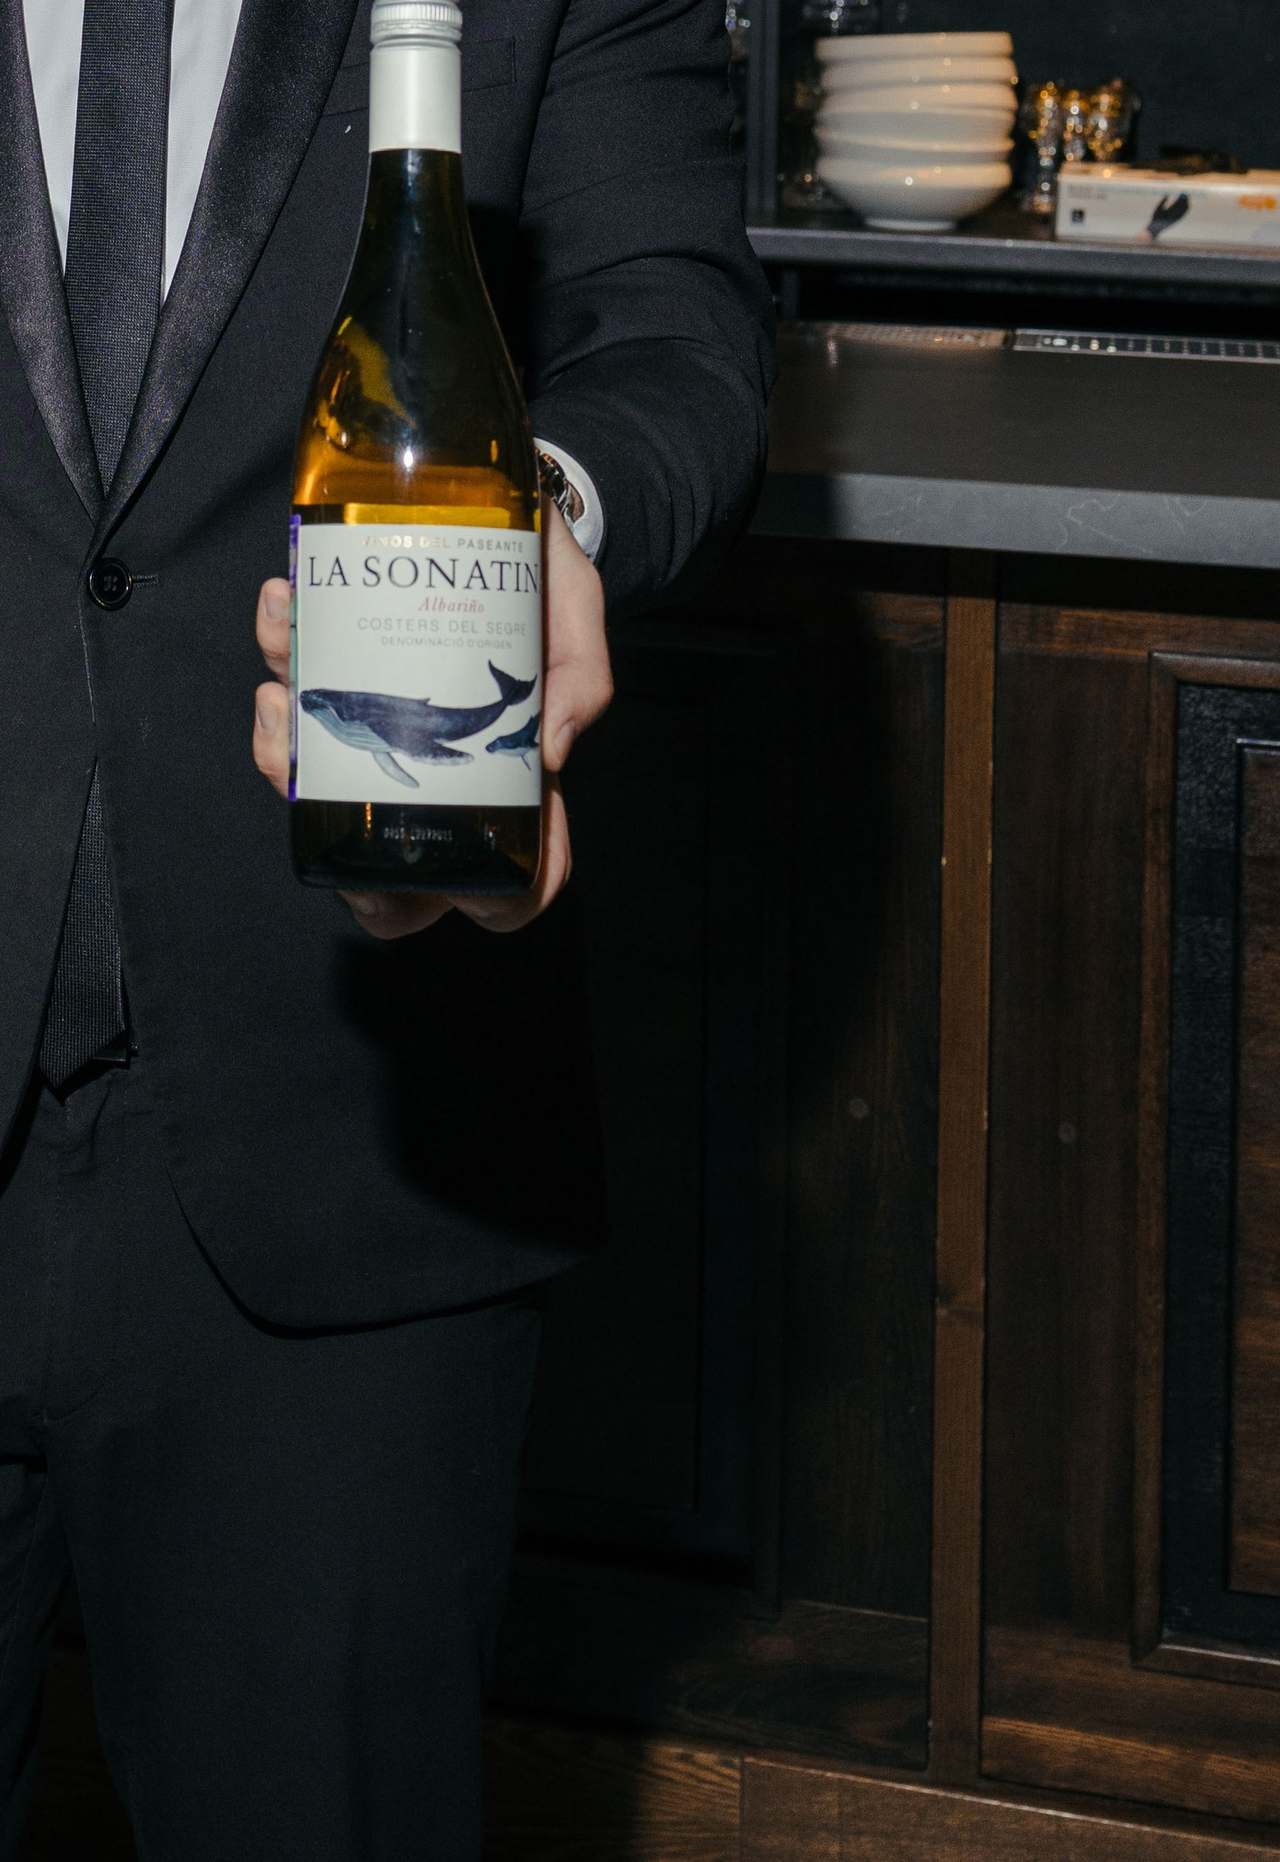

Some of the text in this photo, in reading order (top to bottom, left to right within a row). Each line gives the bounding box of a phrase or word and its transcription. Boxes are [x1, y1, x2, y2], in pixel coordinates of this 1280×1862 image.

[362, 535, 524, 553] VINOS DEL PASEANTE
[308, 555, 351, 587] LA
[418, 596, 485, 614] Albariño
[357, 617, 527, 637] COSTERS DEL SEGRE
[381, 636, 463, 649] DENOMINACIÓ
